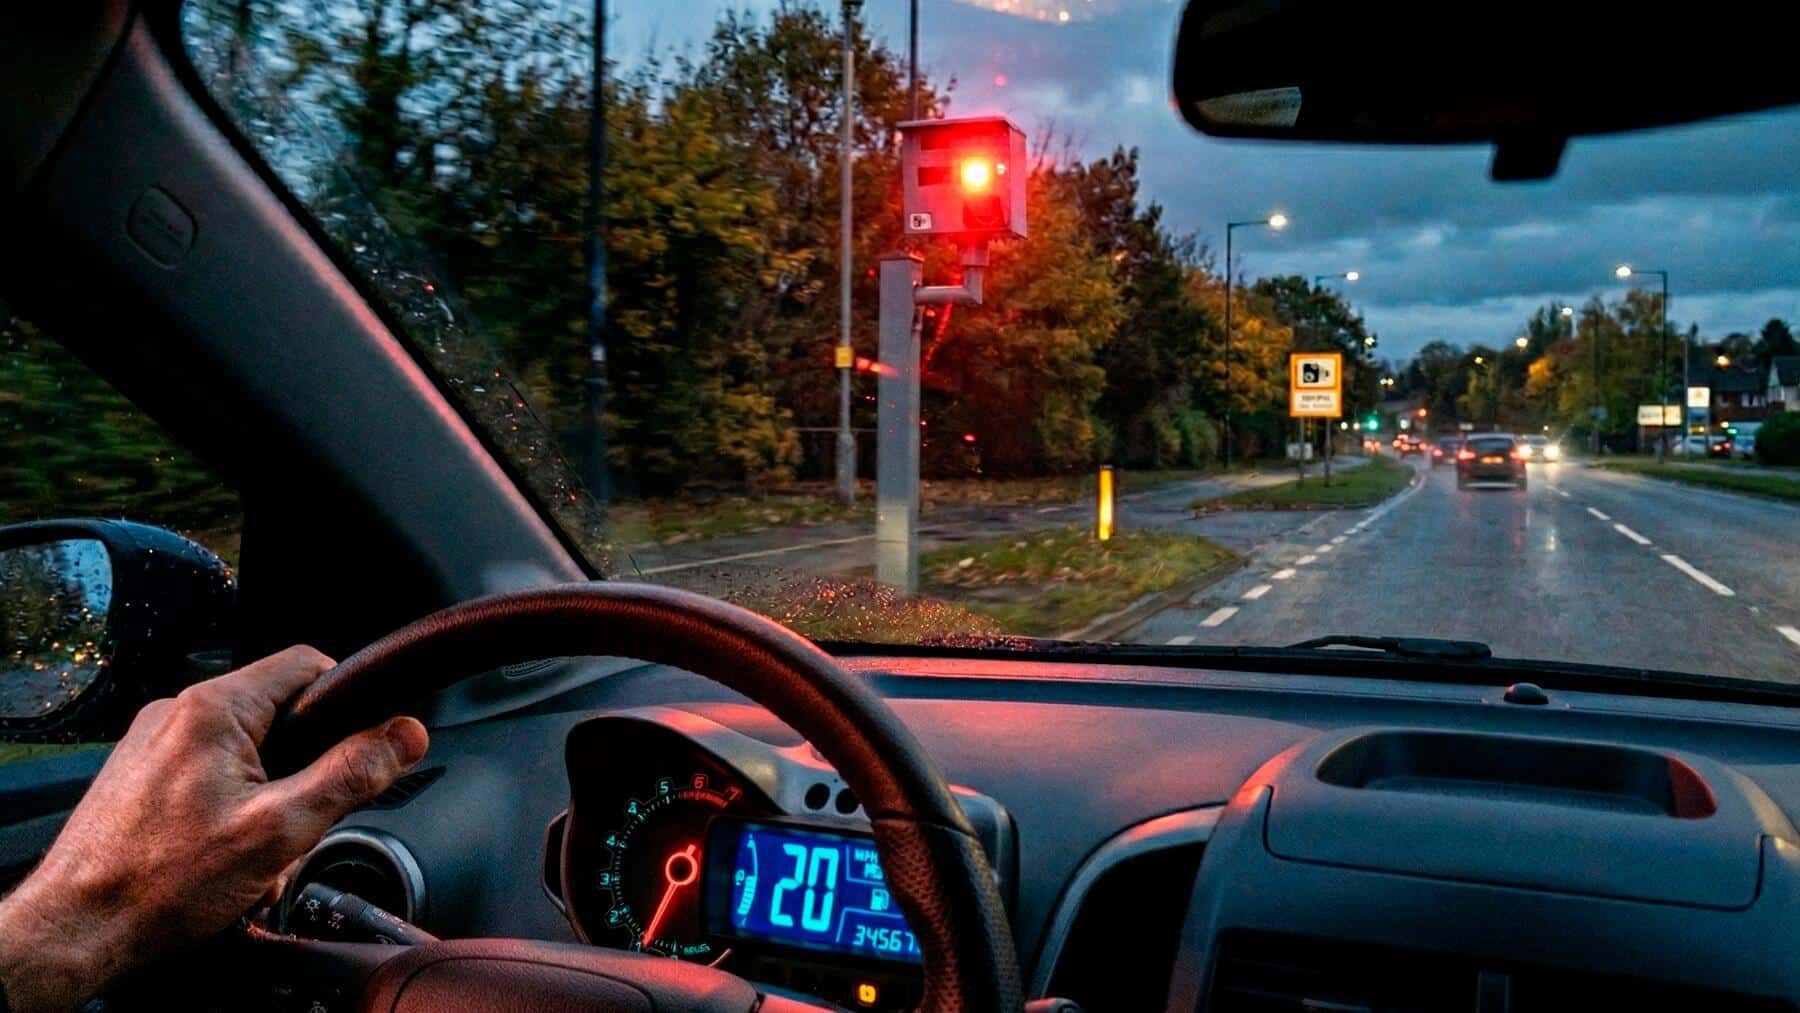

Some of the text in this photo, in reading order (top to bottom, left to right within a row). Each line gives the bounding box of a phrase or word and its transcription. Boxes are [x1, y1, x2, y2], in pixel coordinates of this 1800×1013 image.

[659, 781, 669, 793] 5
[694, 776, 704, 789] 6
[600, 873, 610, 886] 3
[770, 843, 839, 932] 20
[609, 910, 620, 923] 2
